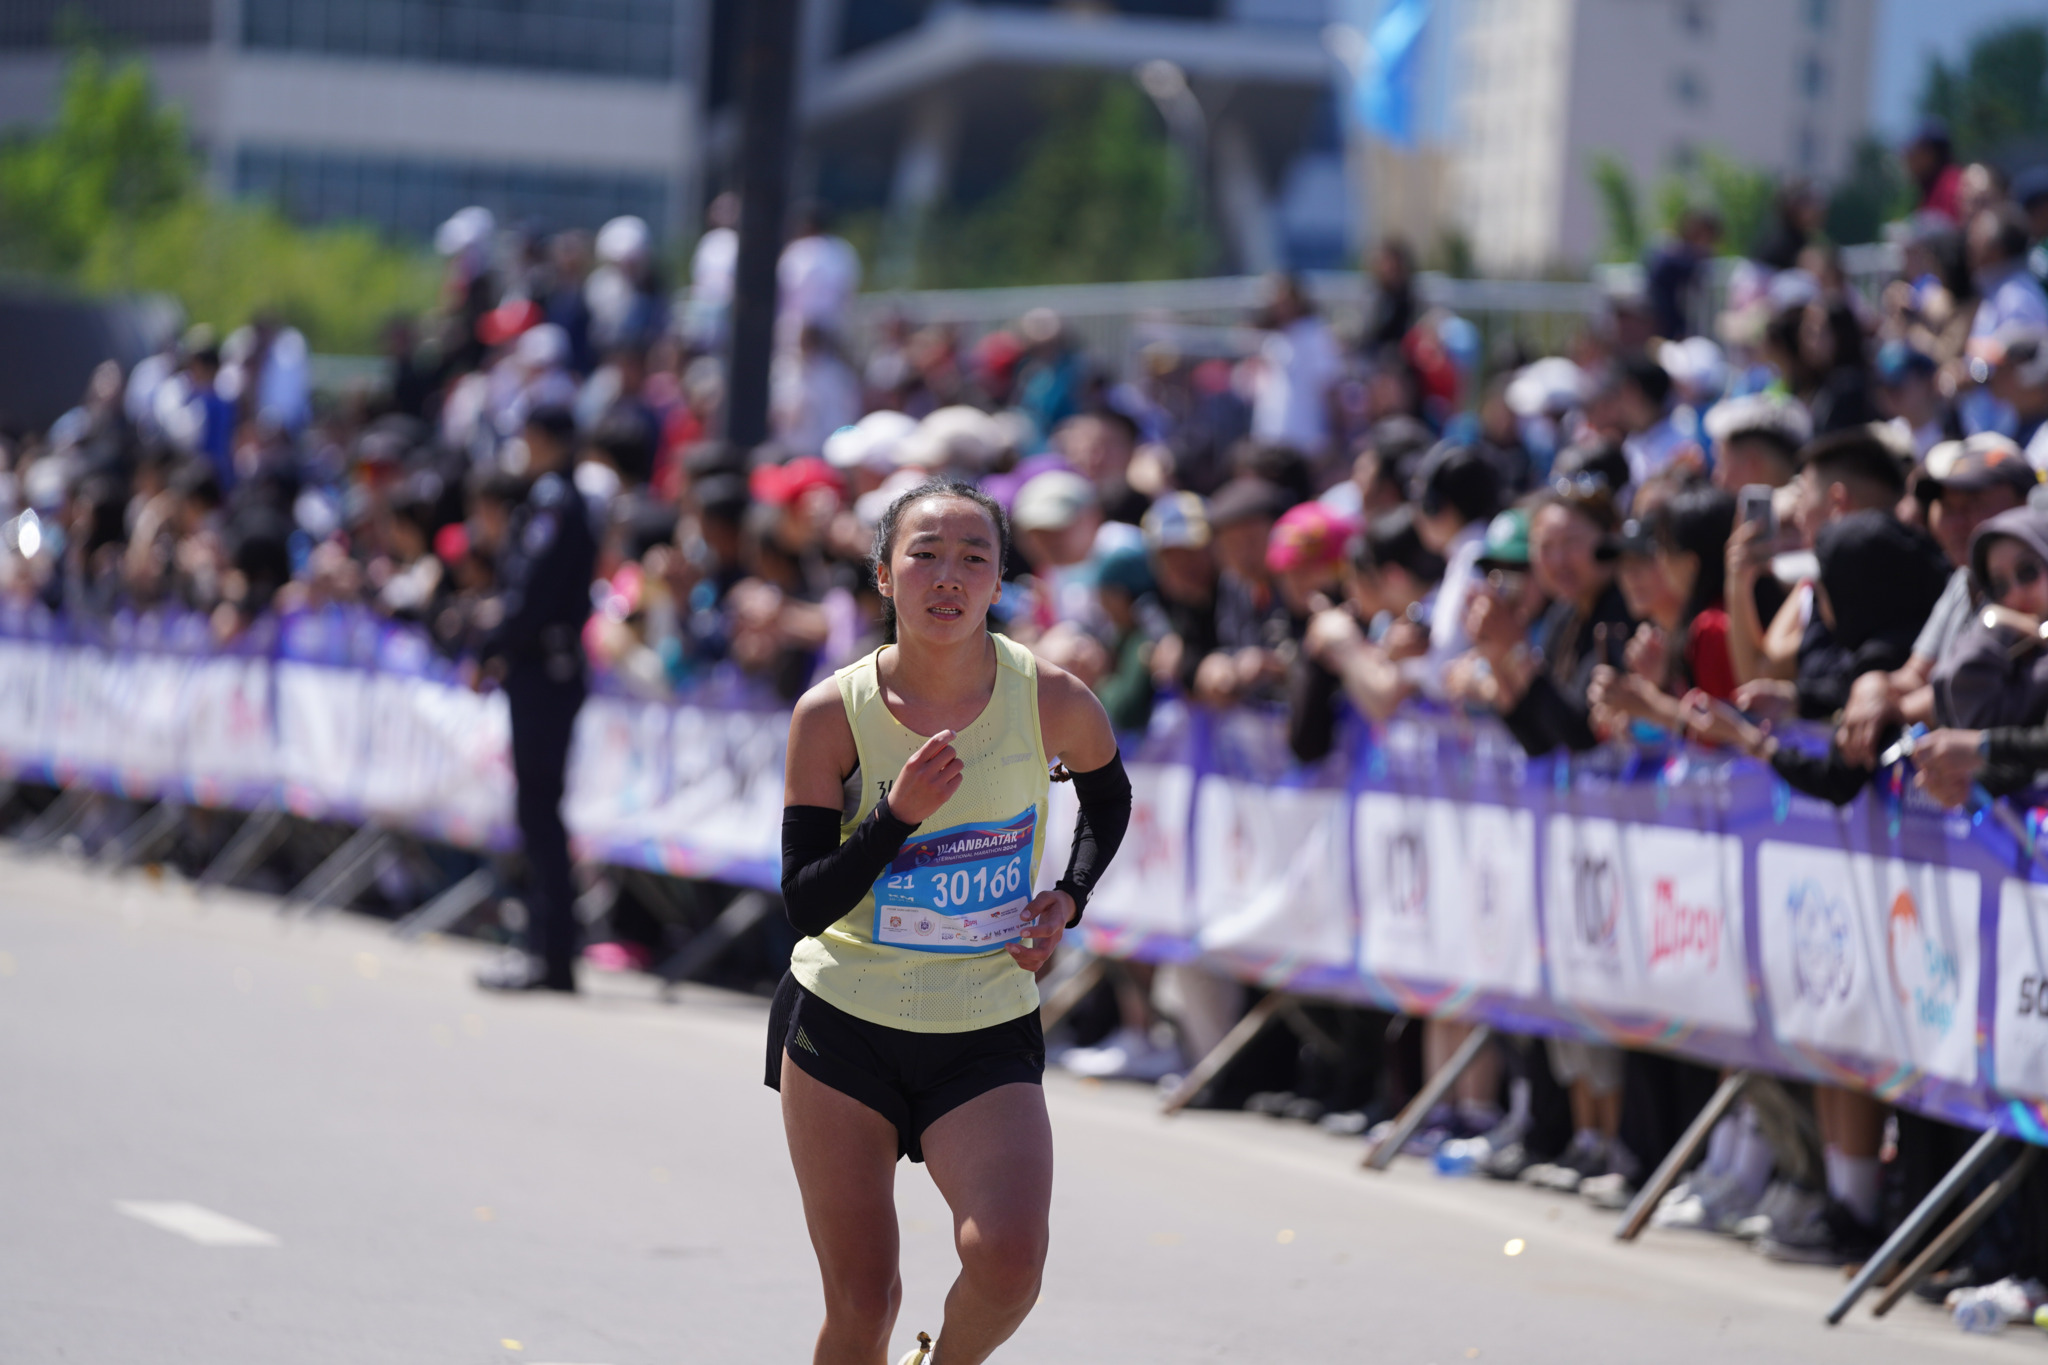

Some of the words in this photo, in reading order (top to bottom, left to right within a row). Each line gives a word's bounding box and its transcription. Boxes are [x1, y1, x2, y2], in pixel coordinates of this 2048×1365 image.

[974, 847, 1003, 856] MARATHON
[1002, 844, 1017, 852] 2024
[888, 874, 915, 889] 21
[931, 856, 1021, 908] 30166
